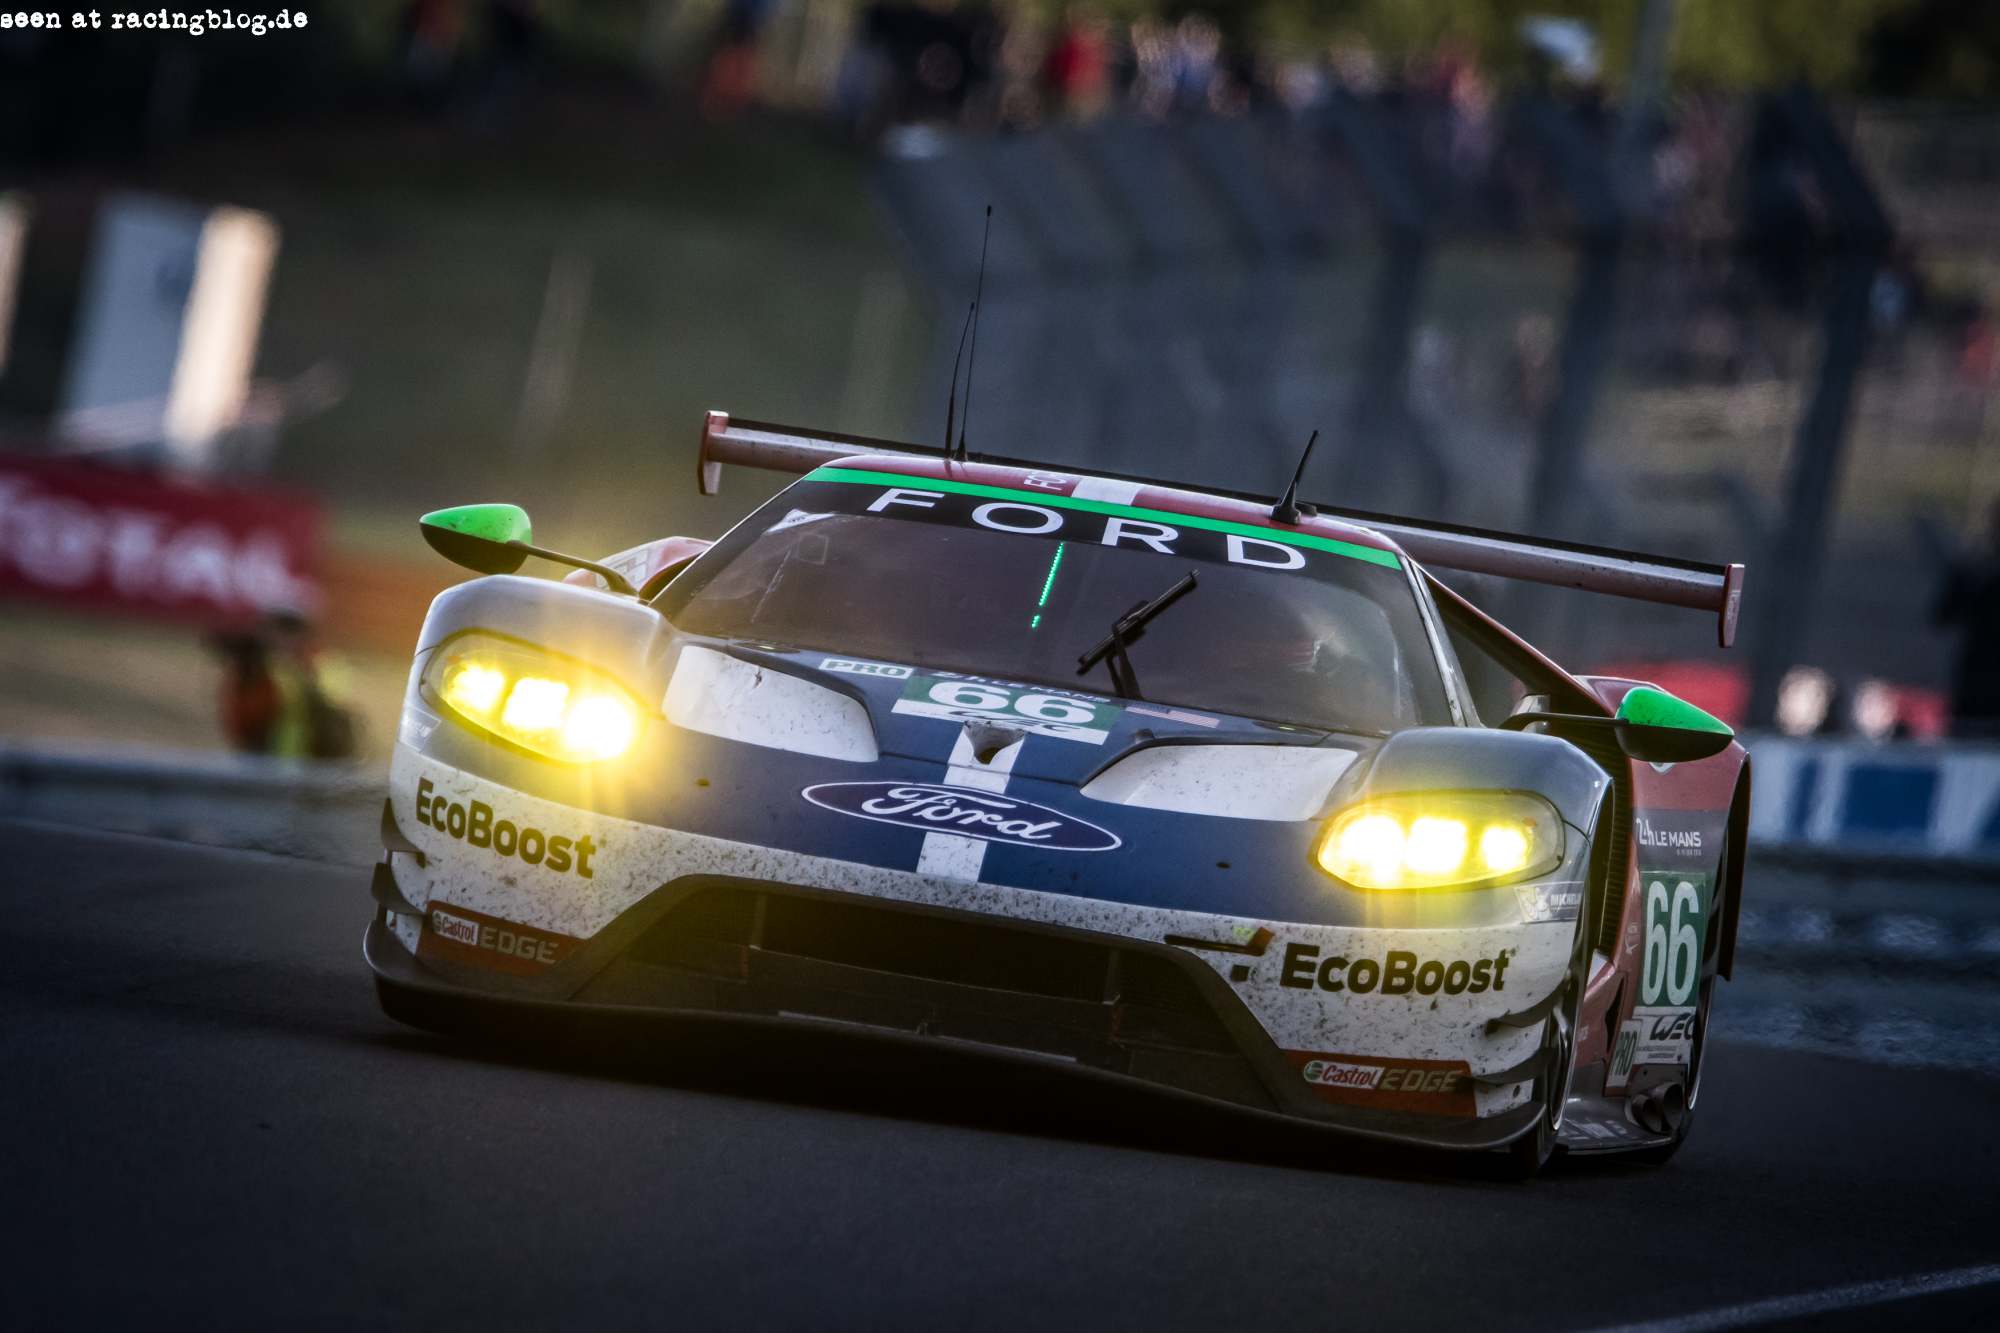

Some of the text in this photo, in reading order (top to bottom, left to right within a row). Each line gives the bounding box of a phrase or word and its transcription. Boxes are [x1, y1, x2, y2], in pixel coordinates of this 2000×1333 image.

[866, 487, 1306, 570] FORD
[825, 661, 908, 677] PRO
[929, 681, 1096, 724] 66
[416, 776, 596, 879] EcoBoost
[861, 787, 1062, 839] Ford
[1655, 830, 1668, 847] LE
[1668, 831, 1702, 848] MANS
[441, 917, 559, 964] Castrol EDGE
[1642, 881, 1699, 1005] 66
[1279, 942, 1512, 995] EcoBoost
[1322, 1064, 1463, 1093] Castrol EDGE
